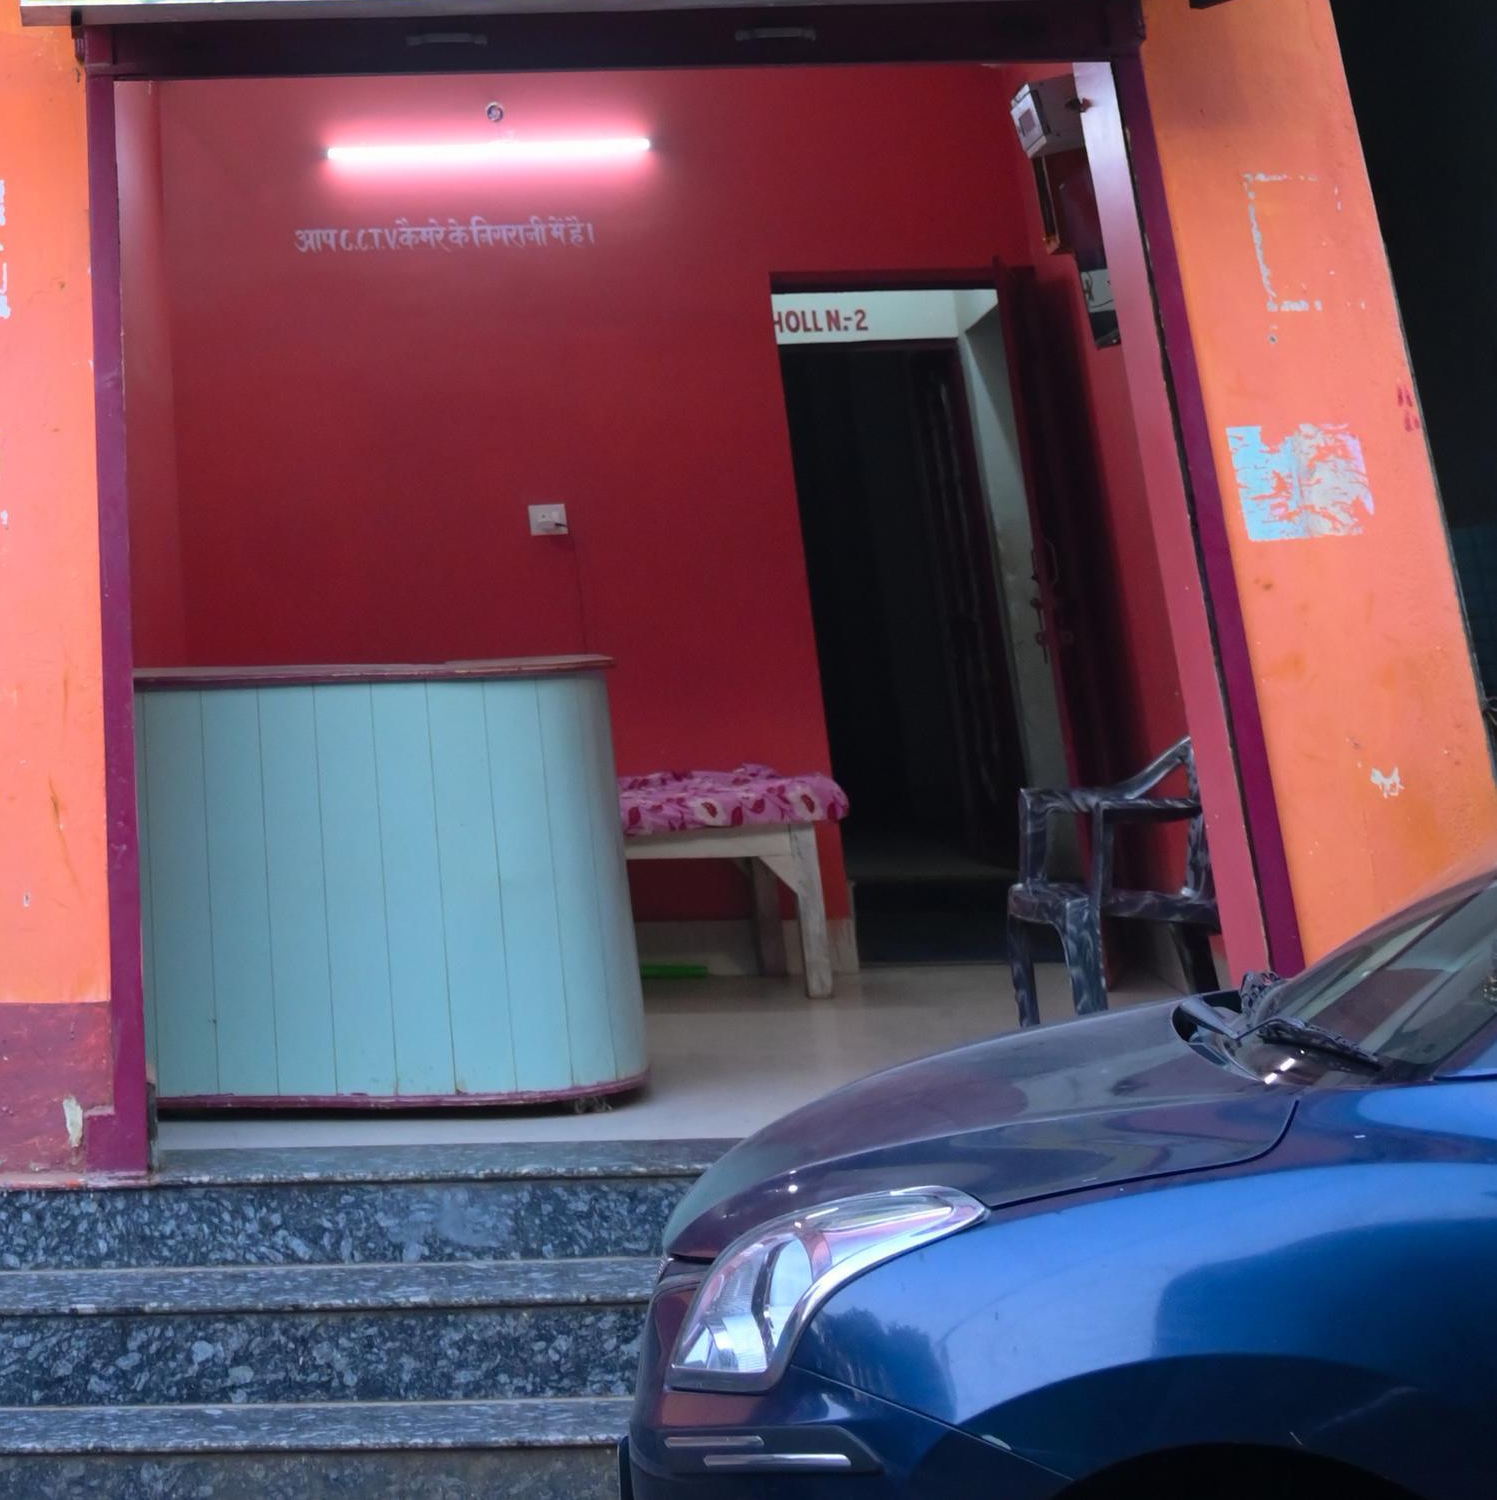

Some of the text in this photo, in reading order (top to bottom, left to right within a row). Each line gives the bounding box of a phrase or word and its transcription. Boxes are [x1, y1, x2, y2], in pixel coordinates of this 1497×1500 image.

[295, 227, 337, 253] आप
[447, 217, 469, 247] के
[548, 215, 570, 245] में
